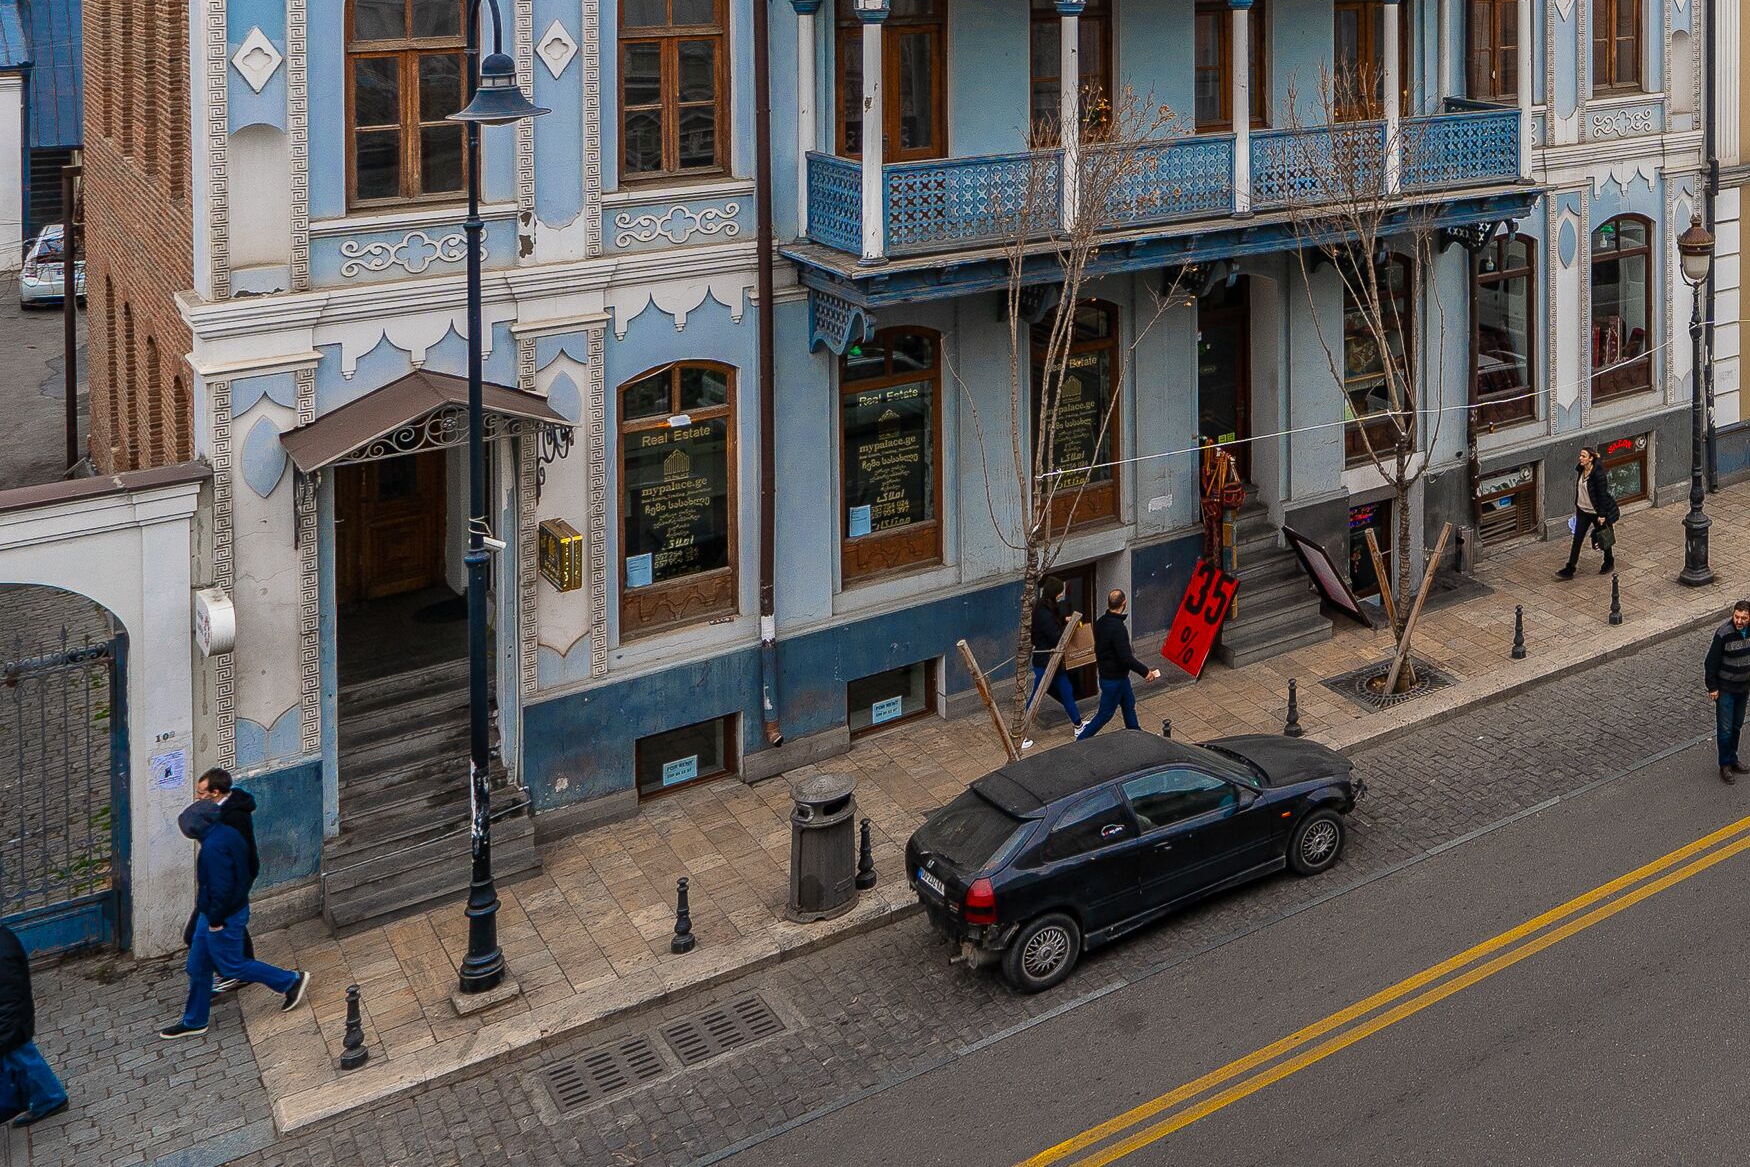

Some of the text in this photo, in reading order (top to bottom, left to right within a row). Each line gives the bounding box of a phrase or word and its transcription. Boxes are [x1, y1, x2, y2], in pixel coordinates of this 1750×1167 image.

[642, 426, 711, 447] Real Estate
[859, 435, 916, 453] mypalace.ge
[641, 477, 708, 498] mypalace.ge
[1184, 564, 1235, 626] 35
[1177, 625, 1199, 664] %
